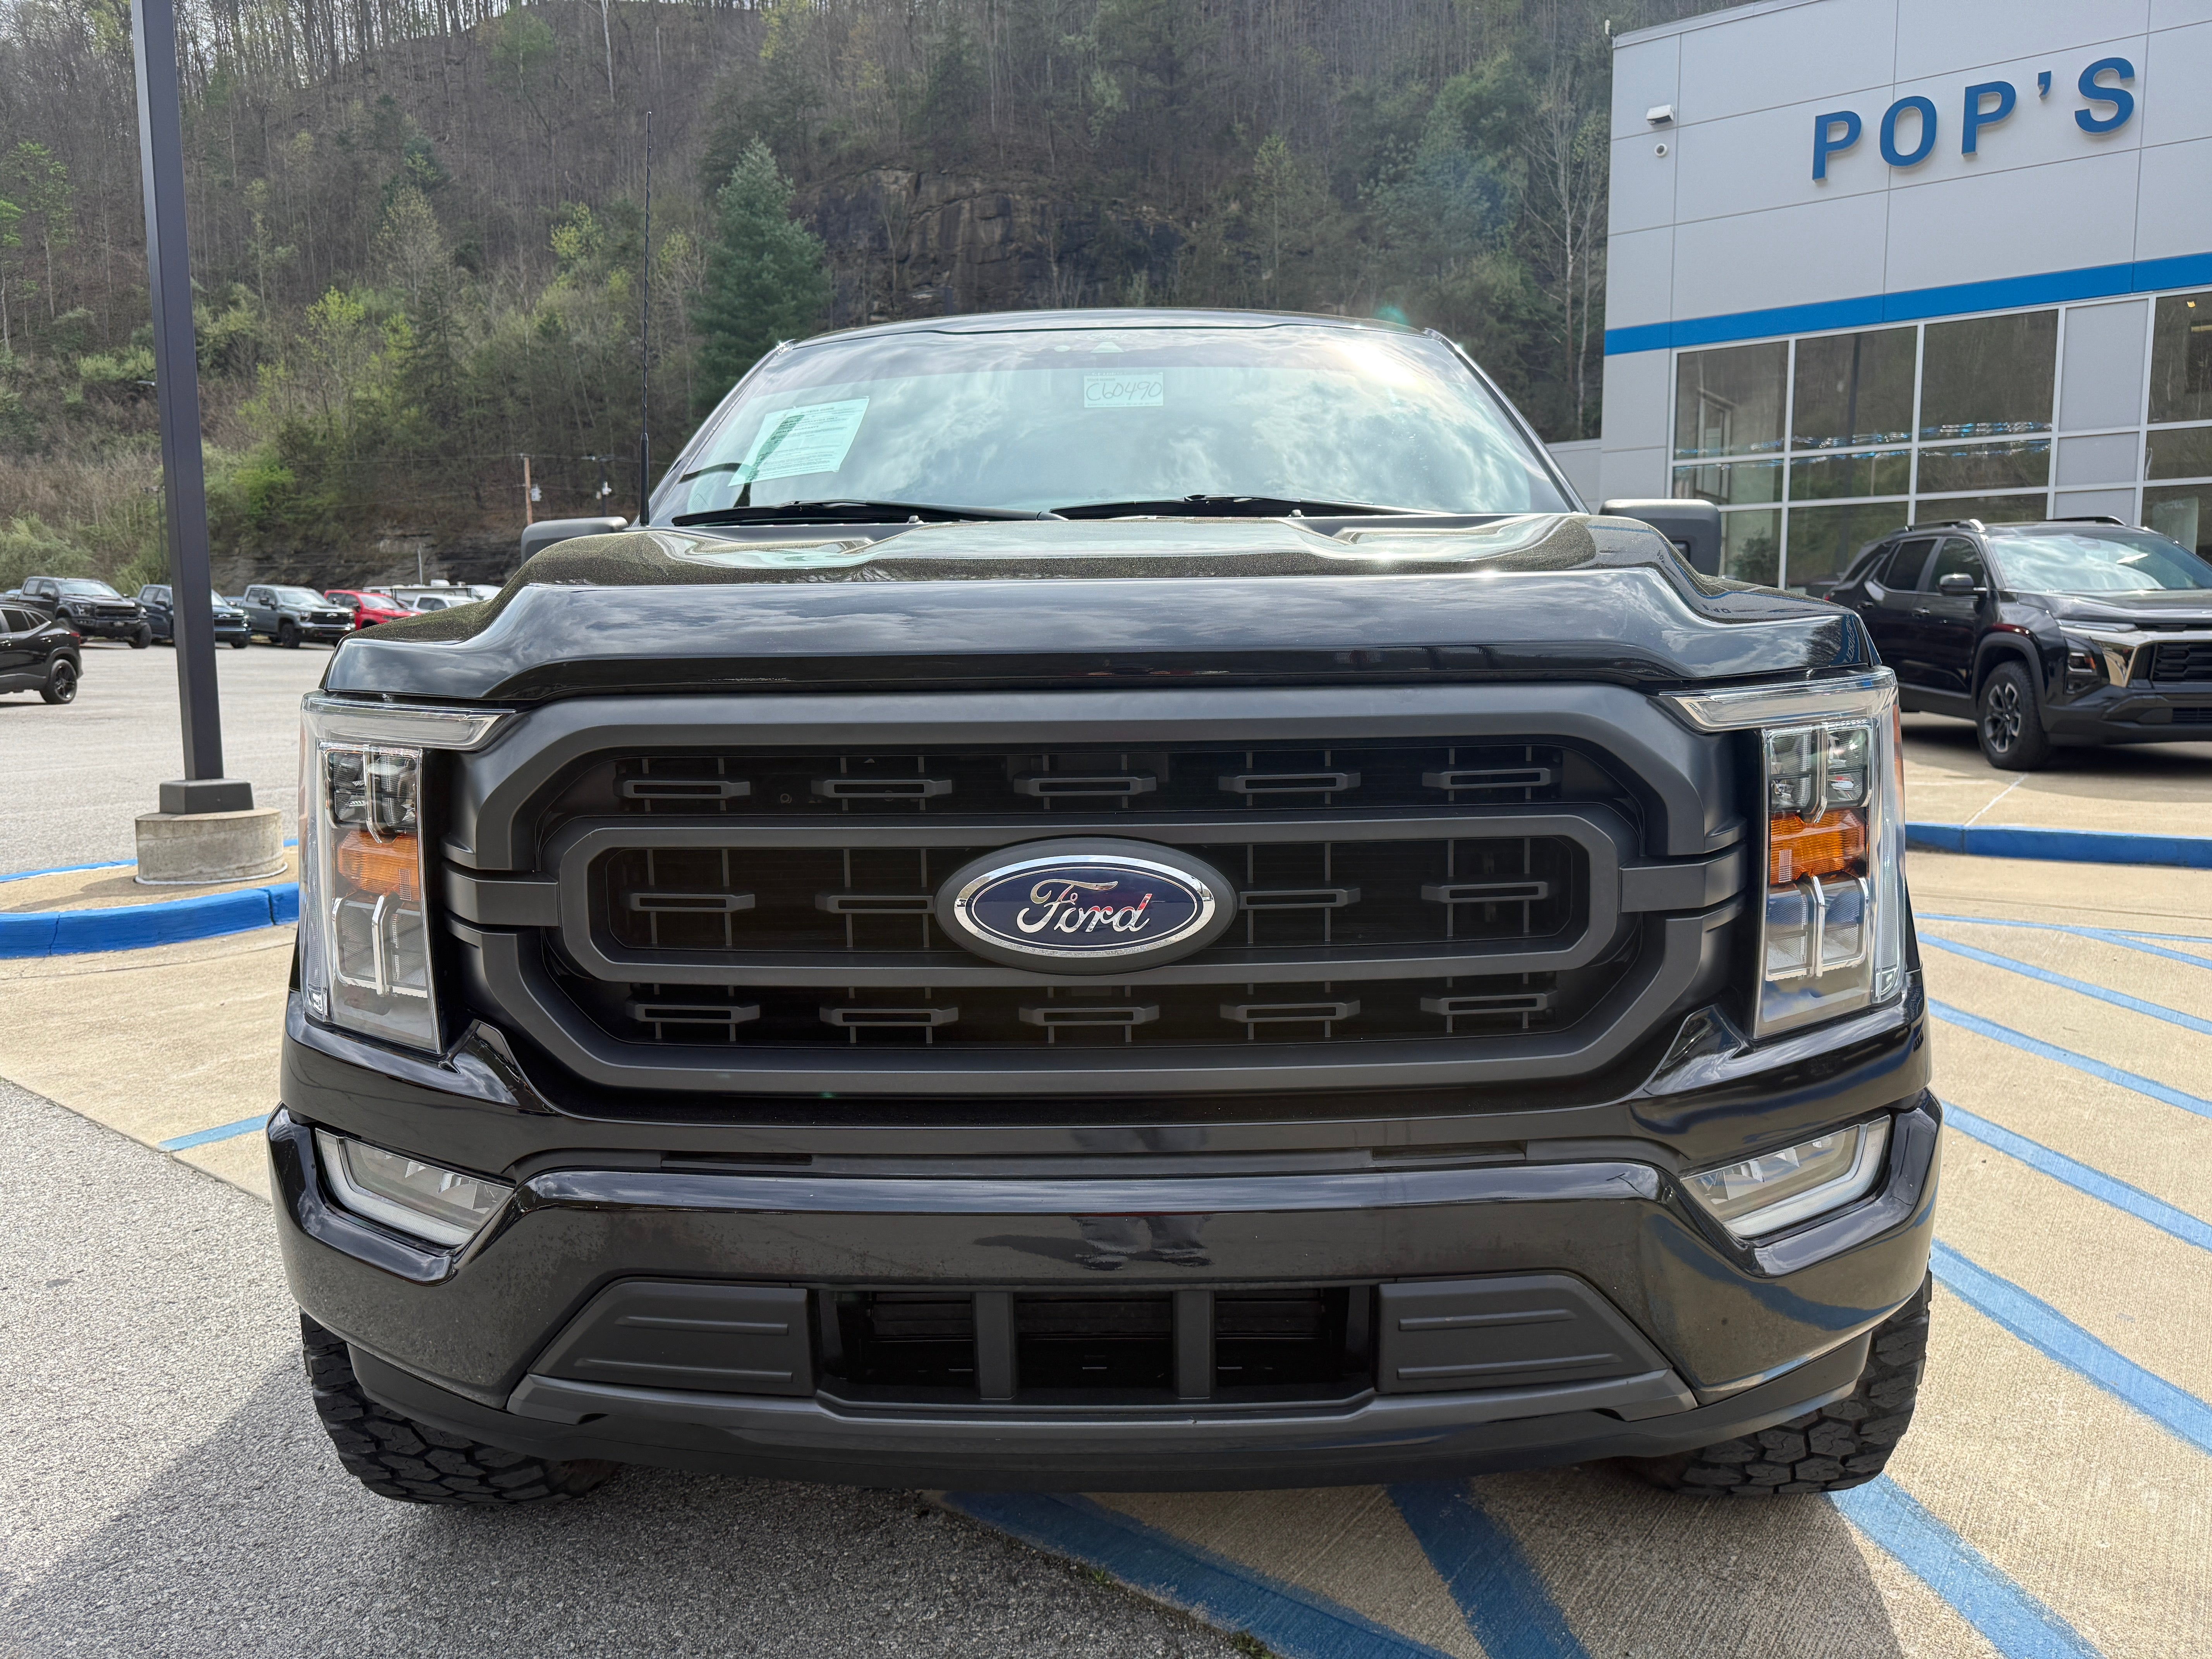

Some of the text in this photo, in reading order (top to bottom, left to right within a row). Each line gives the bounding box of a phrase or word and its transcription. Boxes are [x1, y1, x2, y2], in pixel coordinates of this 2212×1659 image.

[1812, 57, 2135, 182] POP'S
[1086, 381, 1162, 401] C60490
[1017, 879, 1152, 933] Ford
